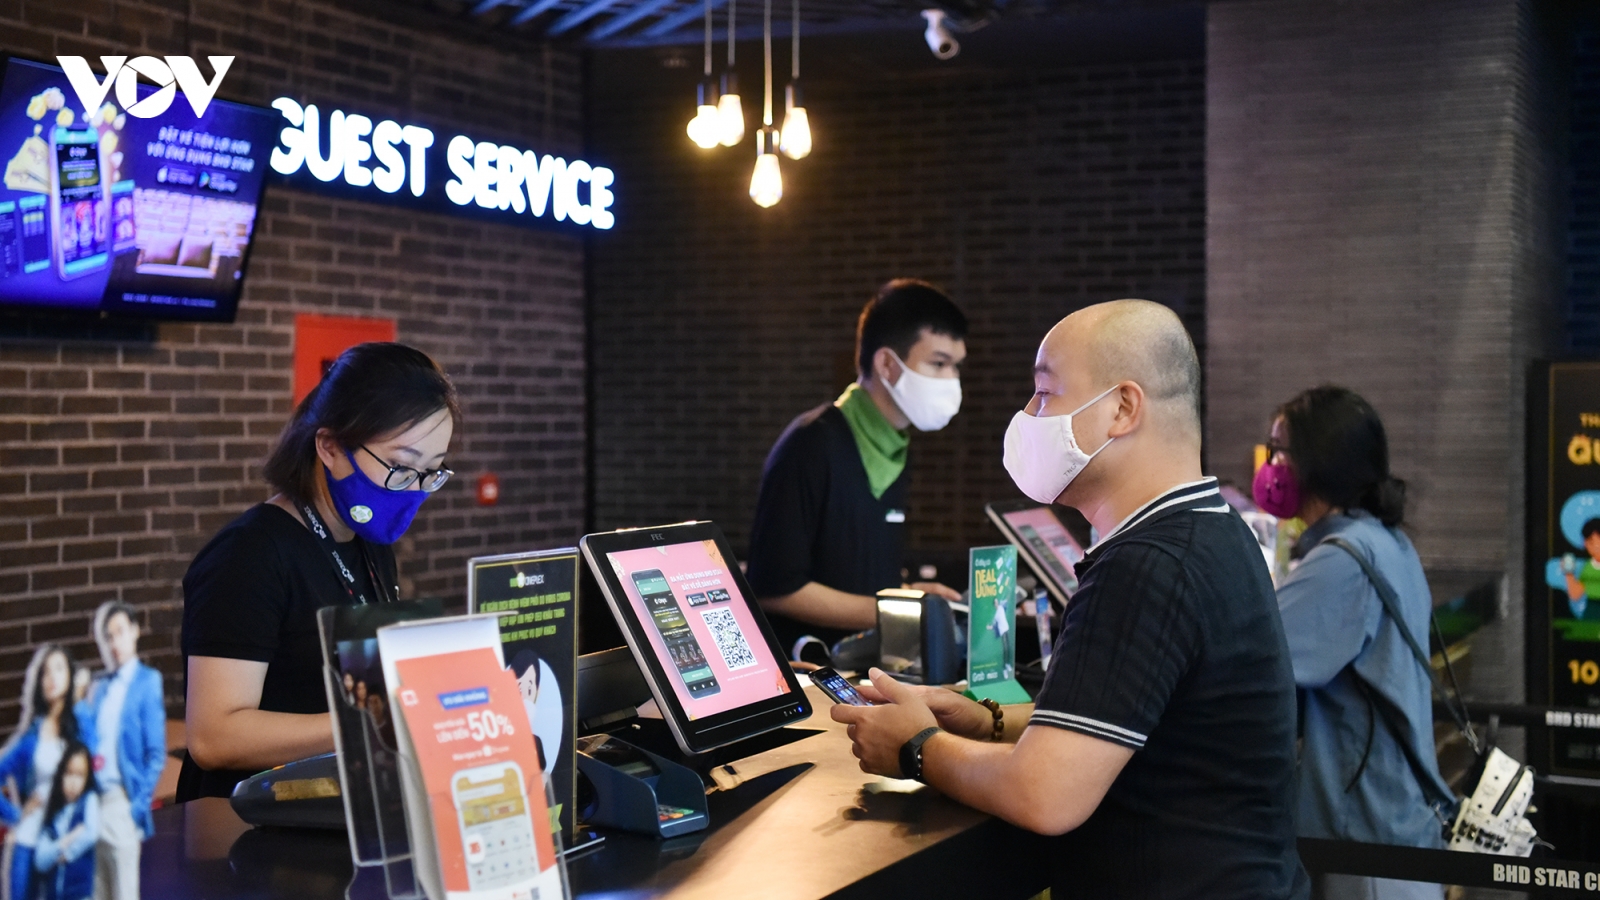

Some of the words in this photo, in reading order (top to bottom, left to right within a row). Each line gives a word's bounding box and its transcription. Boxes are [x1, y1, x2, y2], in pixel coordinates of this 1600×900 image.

[270, 97, 434, 197] GUEST
[445, 135, 614, 230] SERVICE
[467, 709, 515, 742] 50%
[1493, 864, 1530, 884] BHD
[1534, 867, 1580, 889] STAR
